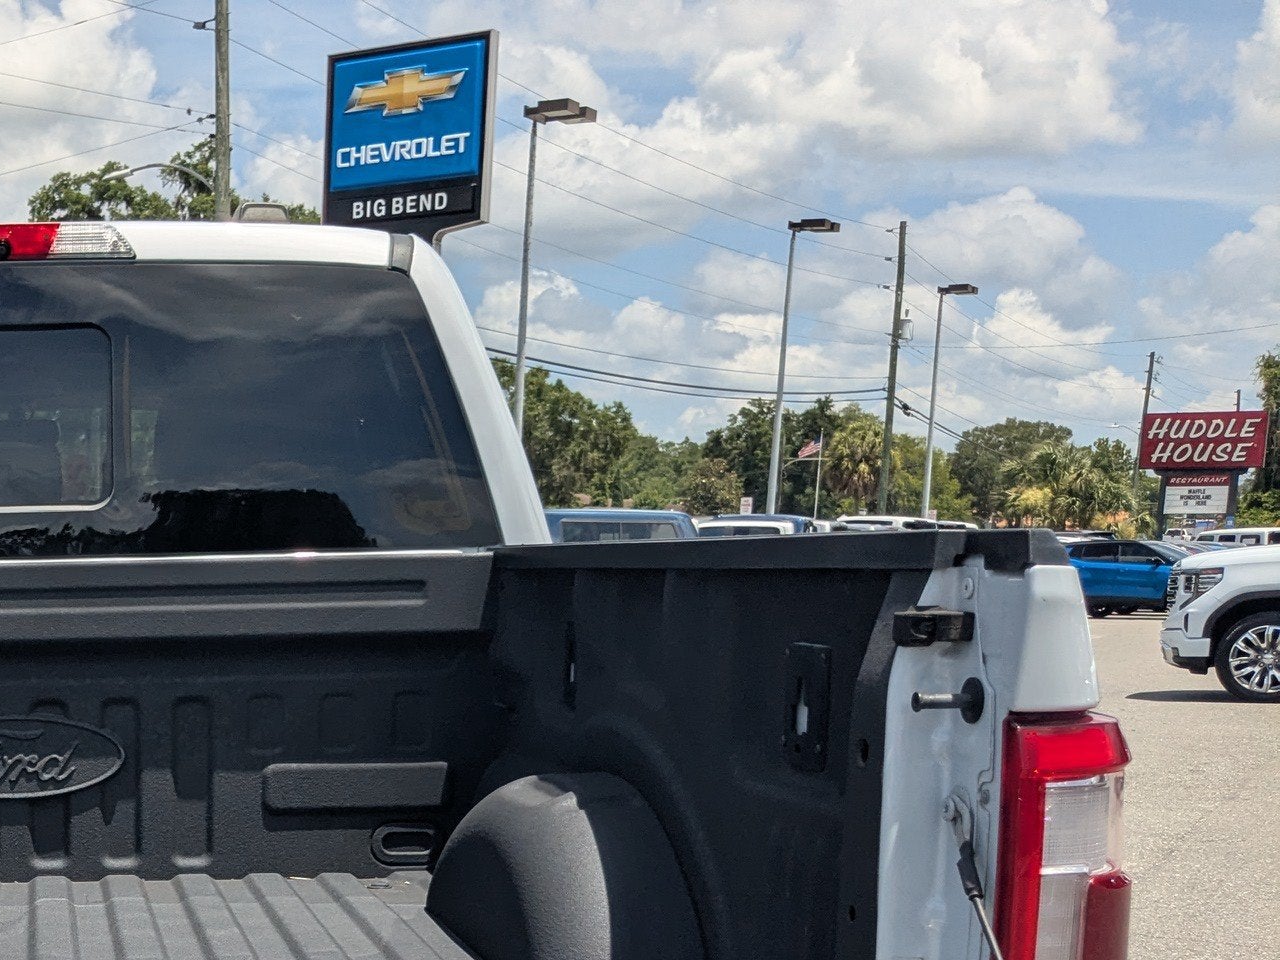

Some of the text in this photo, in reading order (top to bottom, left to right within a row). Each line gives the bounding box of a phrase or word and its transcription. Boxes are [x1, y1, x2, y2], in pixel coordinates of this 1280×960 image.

[336, 132, 471, 168] CHEVROLET
[352, 192, 448, 219] BIG BEND
[1147, 418, 1262, 439] HUDDLE
[1150, 442, 1254, 463] HOUSE
[1169, 476, 1228, 484] RESTAURANT
